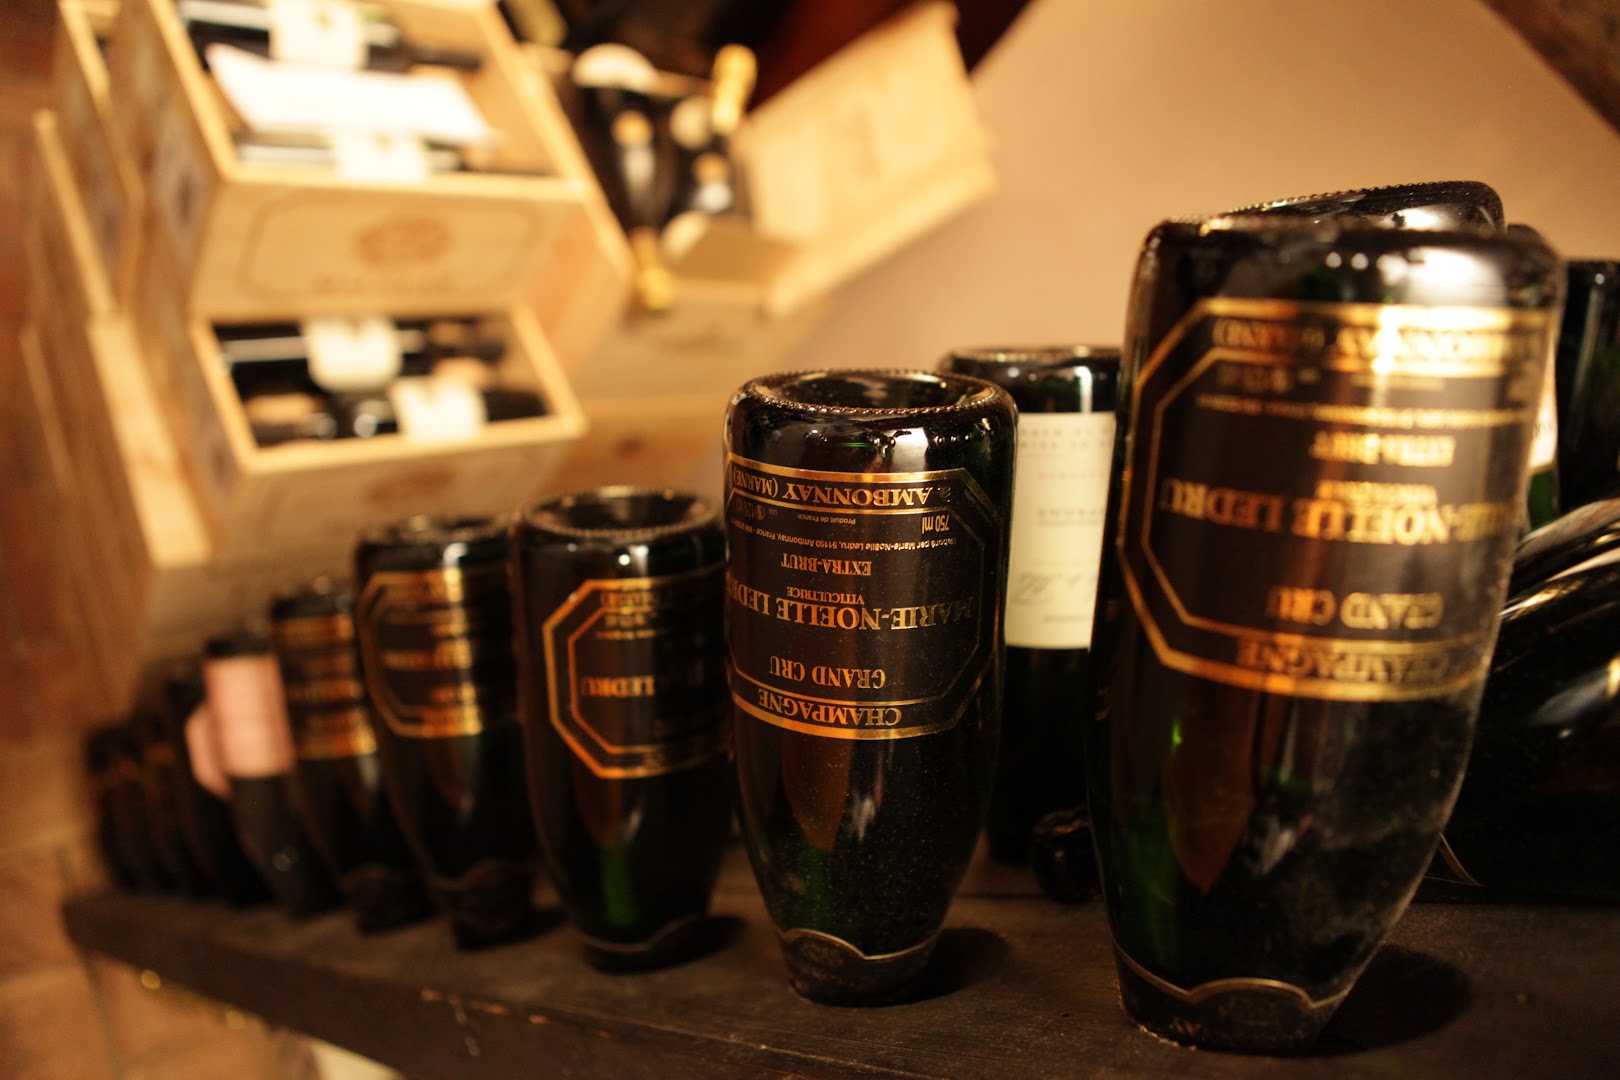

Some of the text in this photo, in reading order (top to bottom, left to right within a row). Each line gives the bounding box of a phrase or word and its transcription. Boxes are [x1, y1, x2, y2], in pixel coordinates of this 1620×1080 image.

[732, 466, 778, 497] (MARNE)
[782, 482, 933, 506] AMBONNAY
[1159, 479, 1283, 532] LEDRU
[797, 513, 856, 525] Produit de France
[921, 514, 950, 534] 750 ml
[756, 529, 775, 540] France
[815, 539, 837, 549] 51150
[780, 553, 872, 576] EXTRA-BRUT
[786, 586, 865, 604] VITICULTRICE
[1266, 586, 1336, 626] CRU
[776, 596, 974, 630] MARIE-NOELLE
[769, 656, 886, 689] GRAND CRU
[580, 676, 655, 697] LEDRU
[758, 689, 902, 726] CHAMPAGNE
